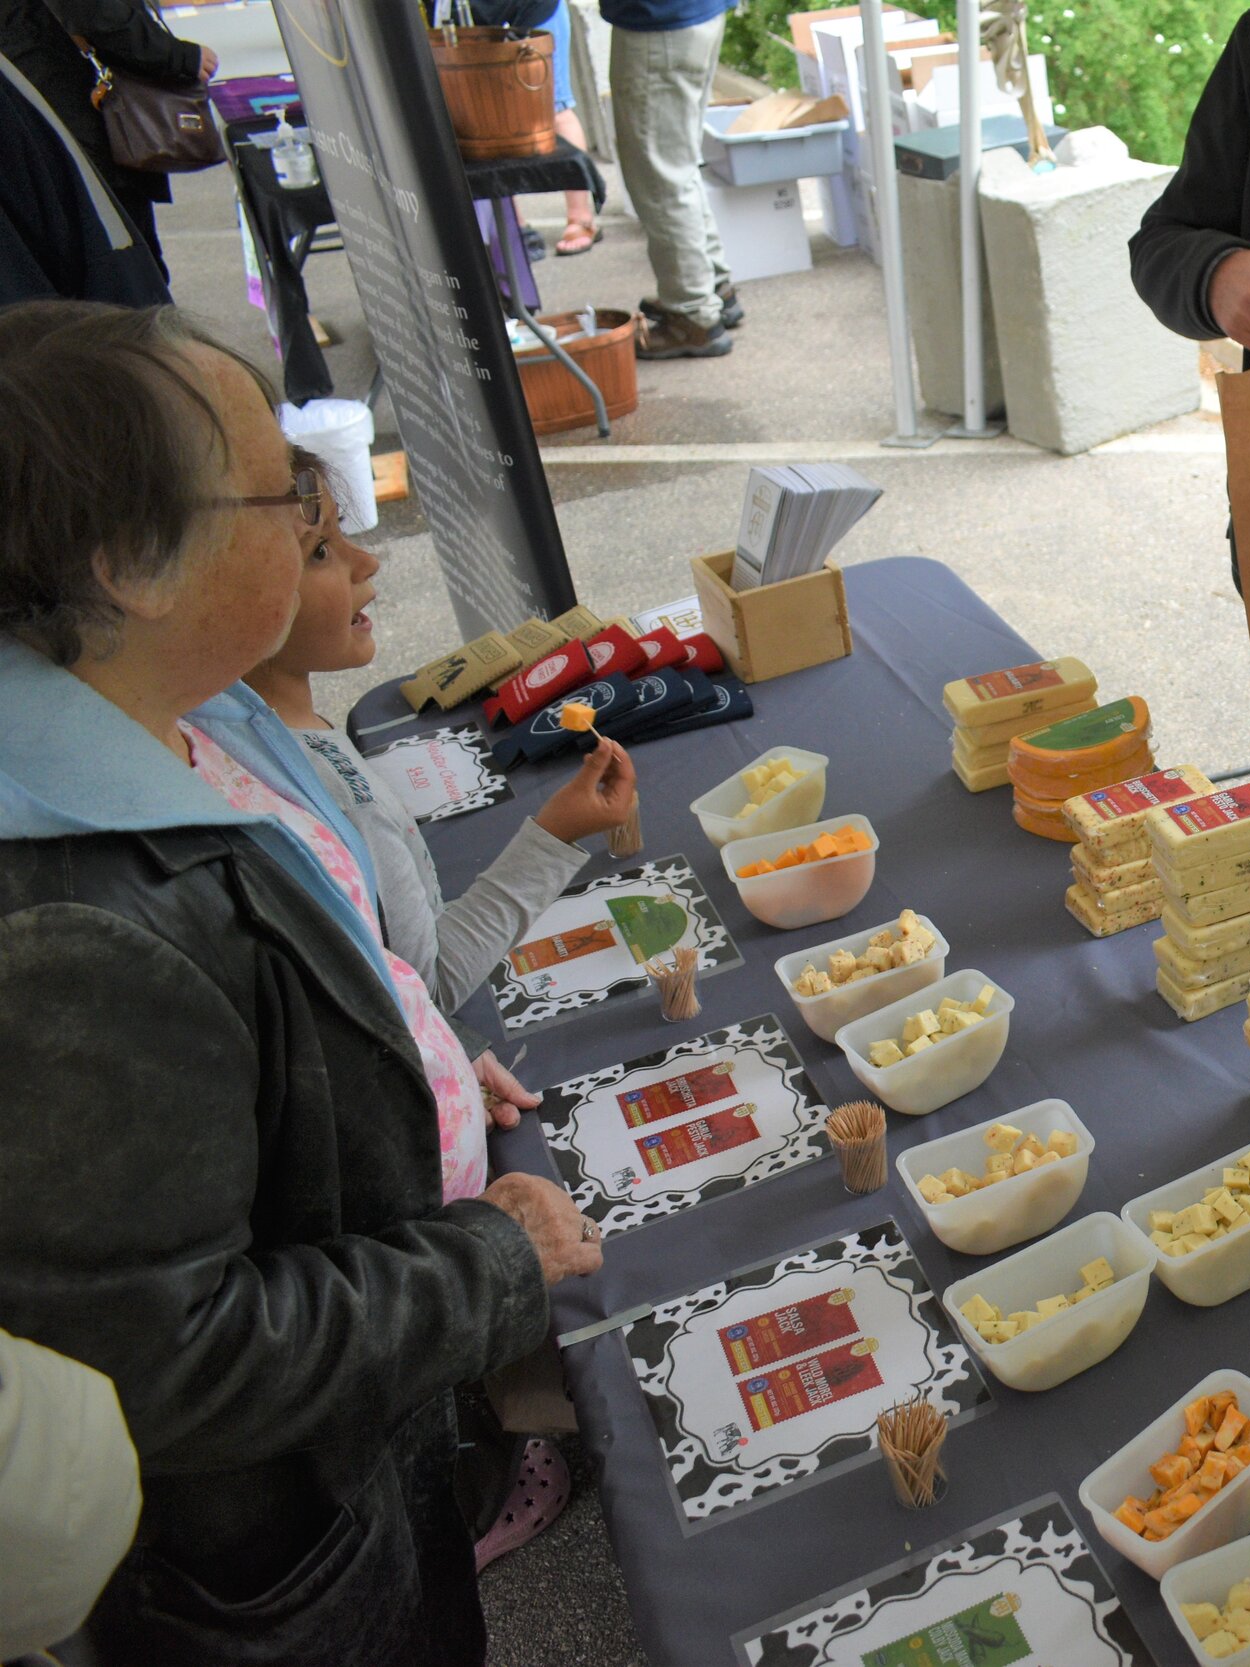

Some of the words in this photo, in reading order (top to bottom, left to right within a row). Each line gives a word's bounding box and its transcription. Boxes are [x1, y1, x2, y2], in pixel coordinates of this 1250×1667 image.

[445, 269, 461, 290] in
[453, 301, 468, 320] in
[456, 327, 480, 350] the
[474, 361, 491, 381] in
[498, 451, 514, 467] to
[1224, 808, 1240, 822] JACK
[686, 1123, 701, 1142] PESTO
[695, 1119, 712, 1140] GARLIC
[693, 1140, 709, 1156] JACK
[775, 1311, 791, 1334] JACK
[786, 1306, 805, 1336] SALSA
[808, 1358, 823, 1377] WILD
[799, 1370, 814, 1389] LEEK
[805, 1387, 822, 1406] JACK
[815, 1377, 833, 1402] MOREL
[928, 1626, 948, 1650] COLBY
[937, 1647, 954, 1665] JACK
